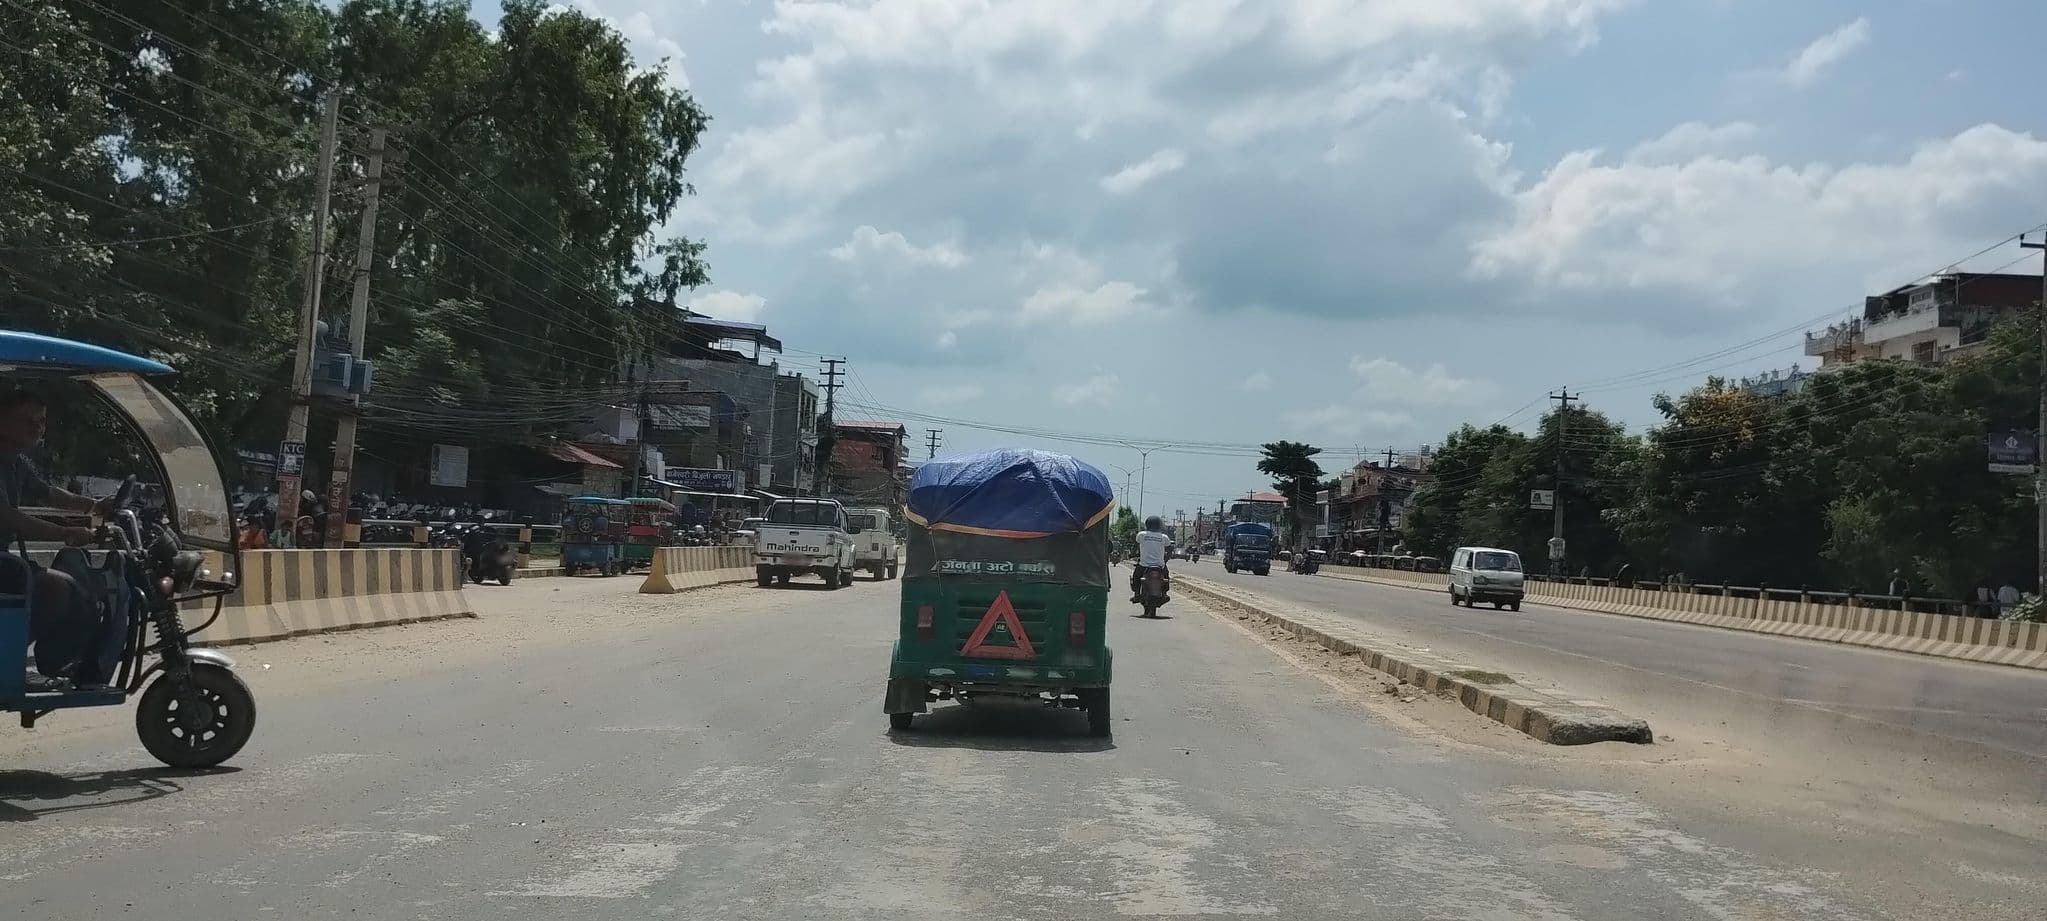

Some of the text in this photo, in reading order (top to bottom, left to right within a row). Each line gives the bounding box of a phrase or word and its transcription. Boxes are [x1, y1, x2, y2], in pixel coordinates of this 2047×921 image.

[283, 443, 304, 454] KTC
[767, 543, 820, 553] Mahindra
[942, 560, 982, 570] जनता
[986, 561, 1014, 572] अटो
